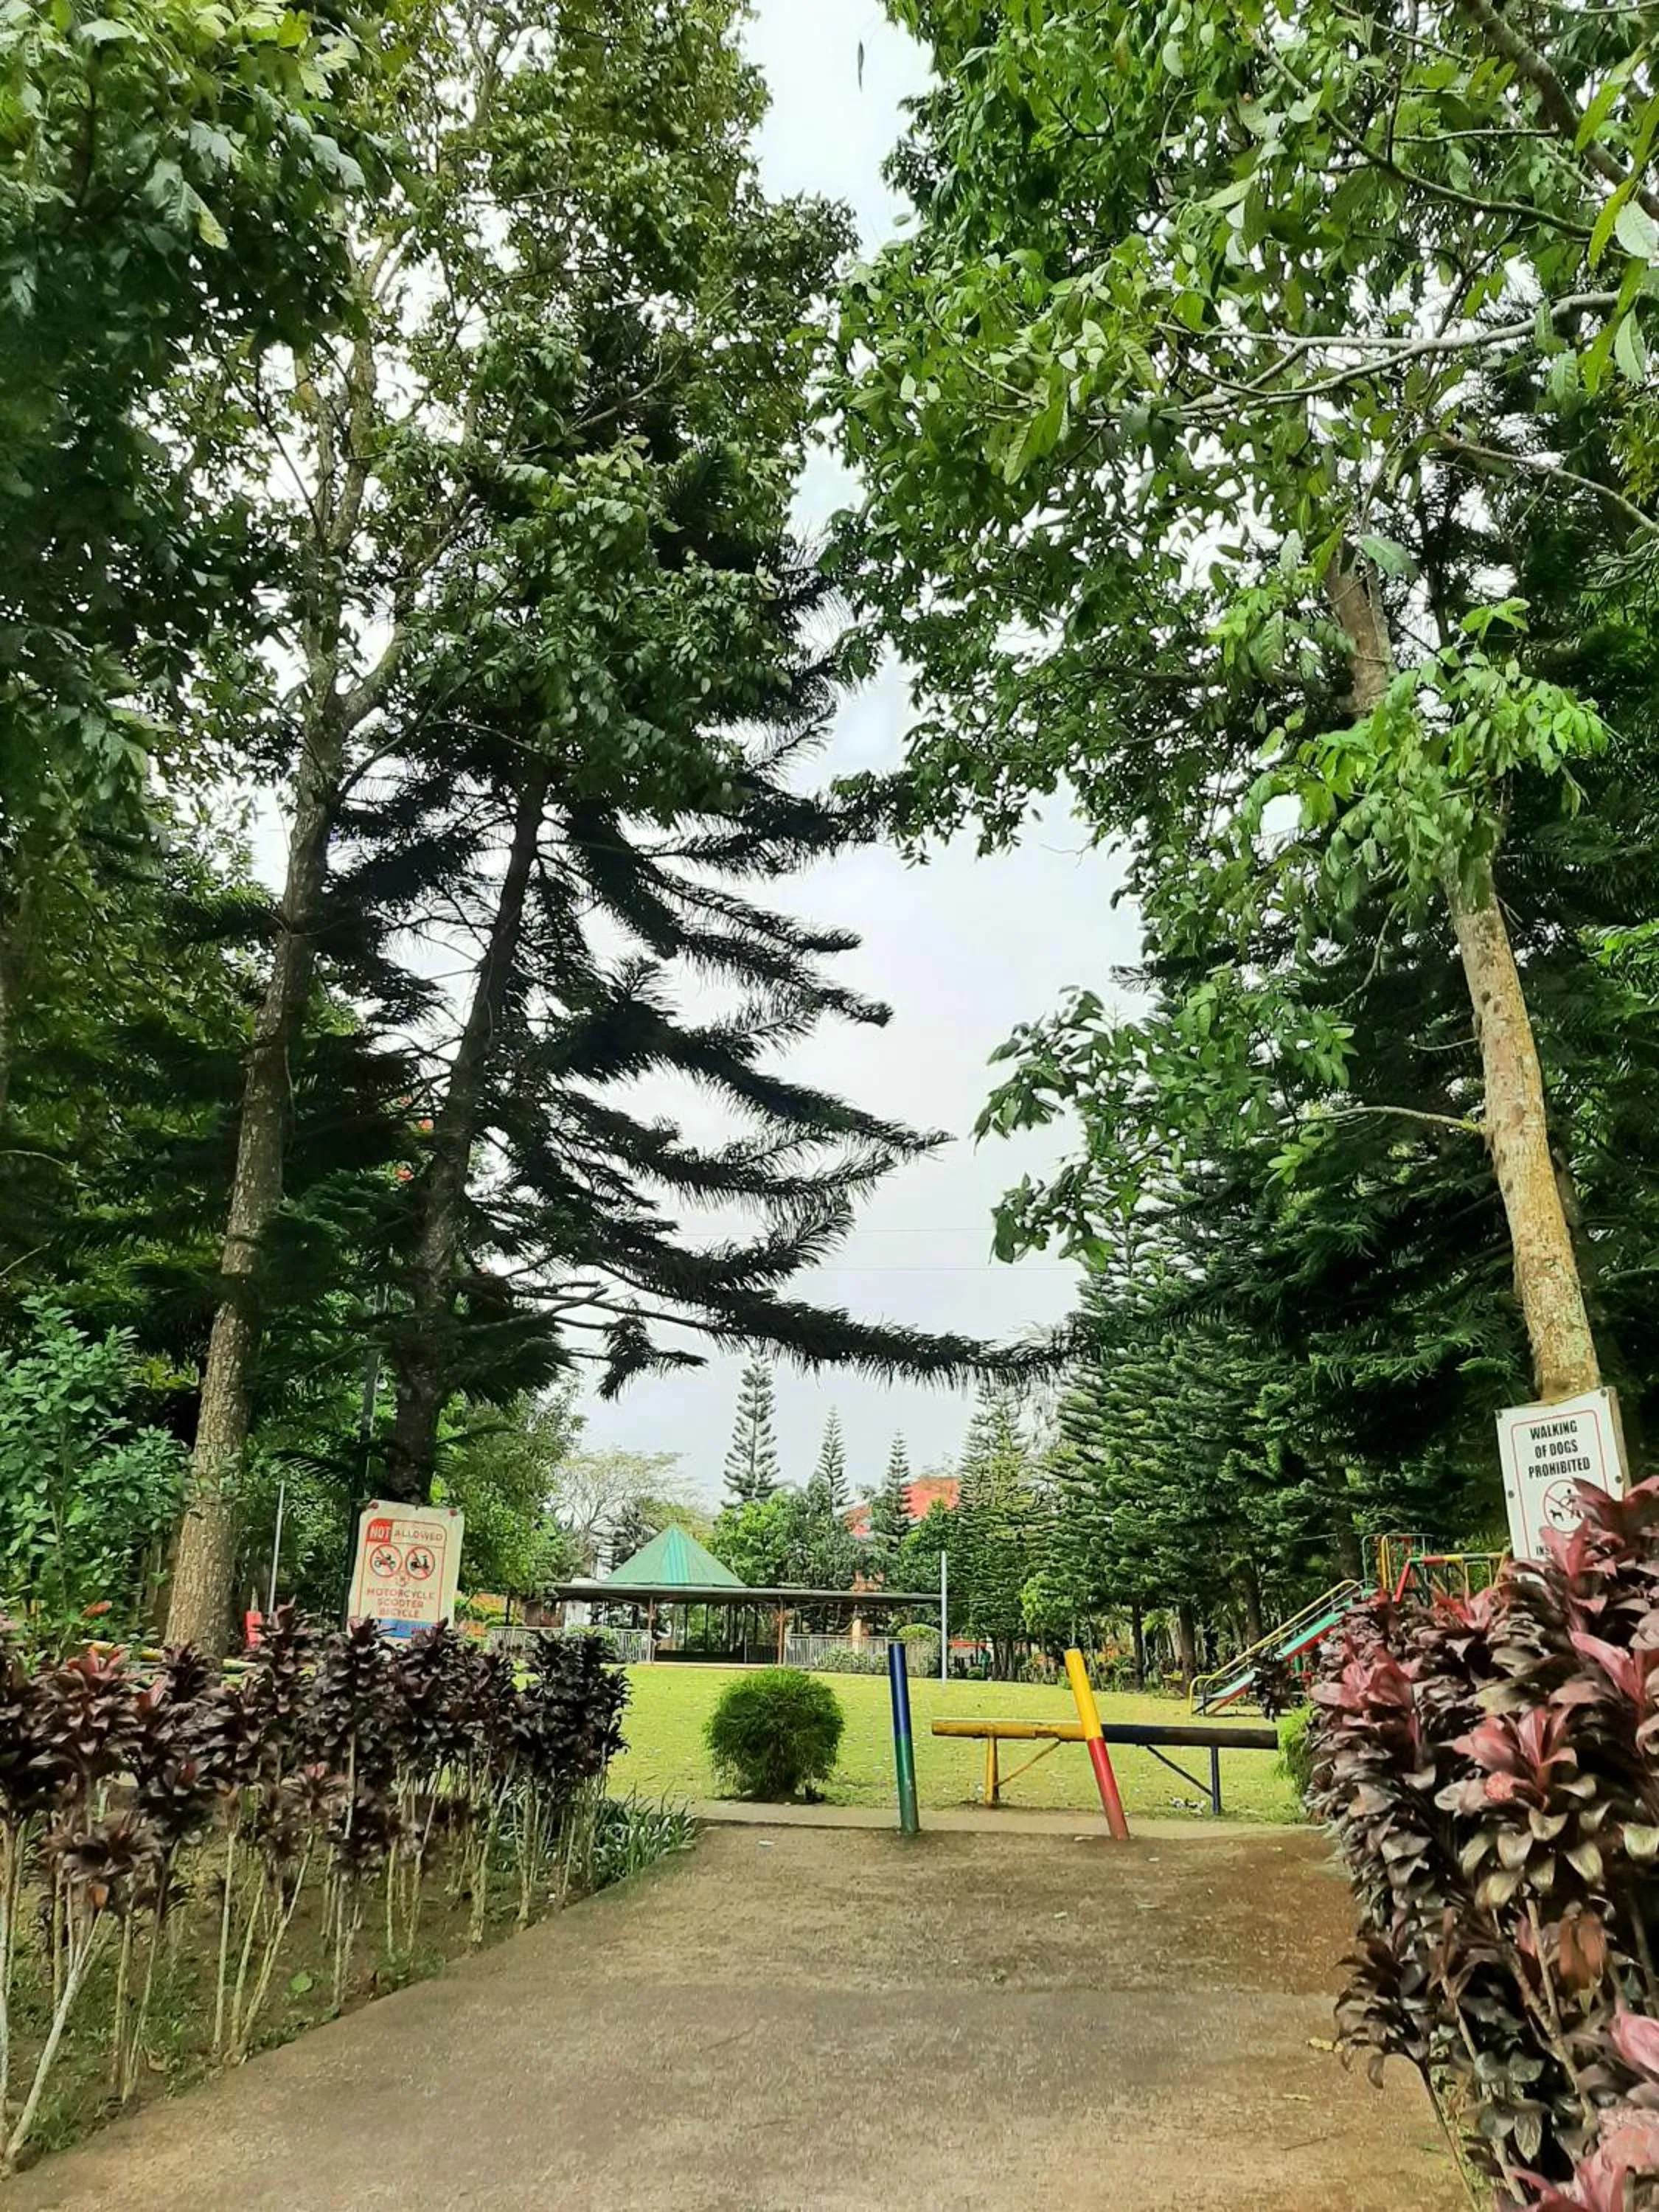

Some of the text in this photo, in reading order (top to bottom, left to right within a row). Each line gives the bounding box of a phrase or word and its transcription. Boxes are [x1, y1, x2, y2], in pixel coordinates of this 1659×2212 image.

[1530, 1420, 1578, 1440] WALKING
[1534, 1439, 1578, 1458] OF DOGS
[1528, 1457, 1590, 1478] PROHIBITED
[371, 1526, 442, 1541] NOT ALLOWED
[366, 1588, 435, 1599] MOTORCYCLE
[378, 1598, 423, 1608] SCOOTER
[378, 1608, 420, 1618] BICYCLE
